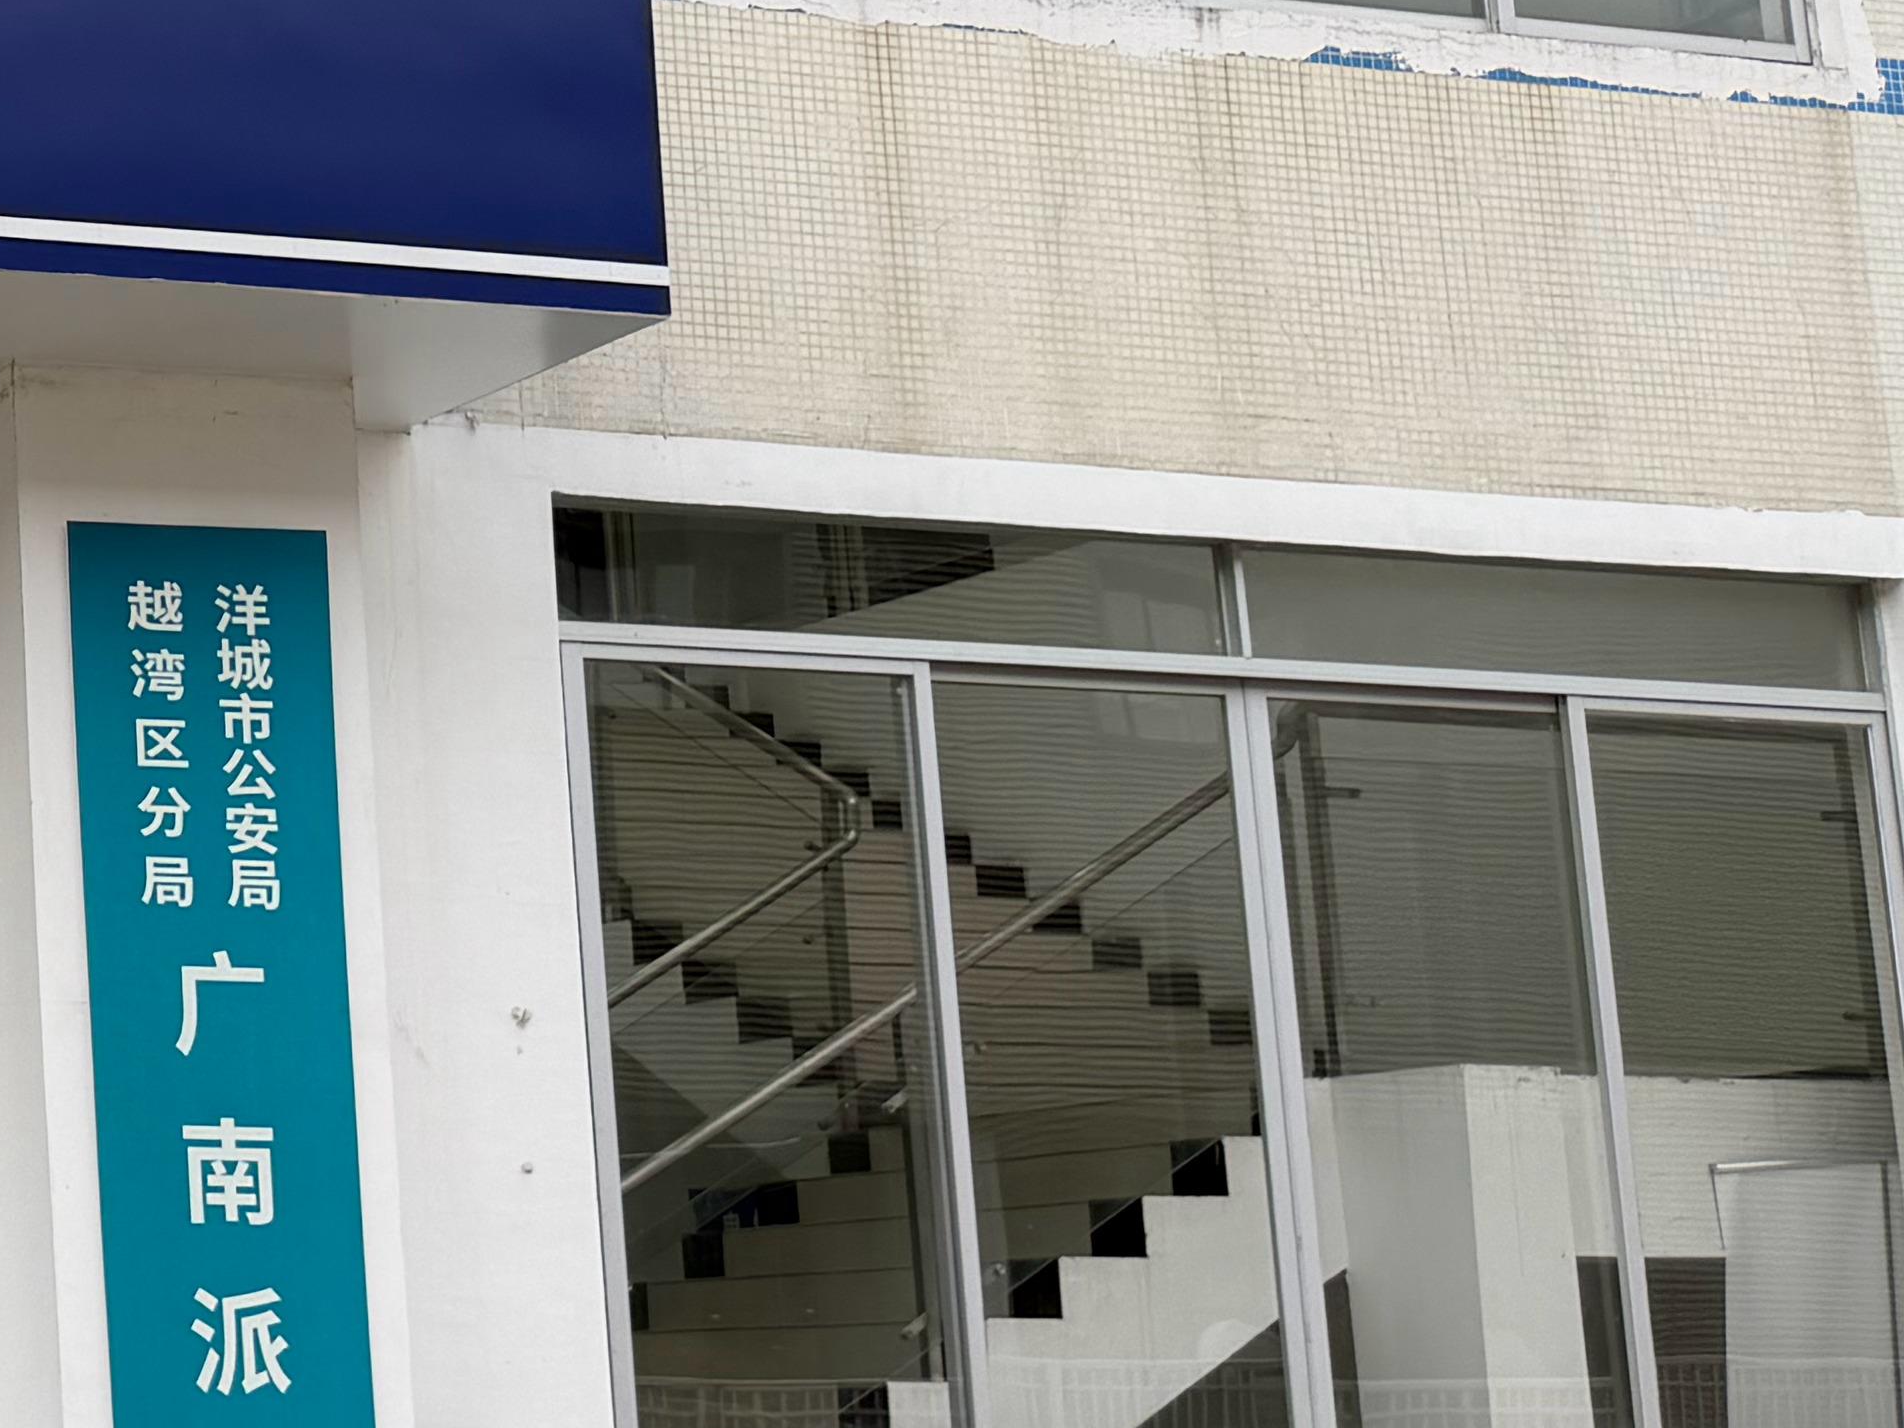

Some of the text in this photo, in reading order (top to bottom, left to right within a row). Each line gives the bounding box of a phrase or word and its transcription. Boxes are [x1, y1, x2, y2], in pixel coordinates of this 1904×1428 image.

[127, 581, 196, 908] 越湾区分局
[215, 584, 280, 911] 洋城市公安局
